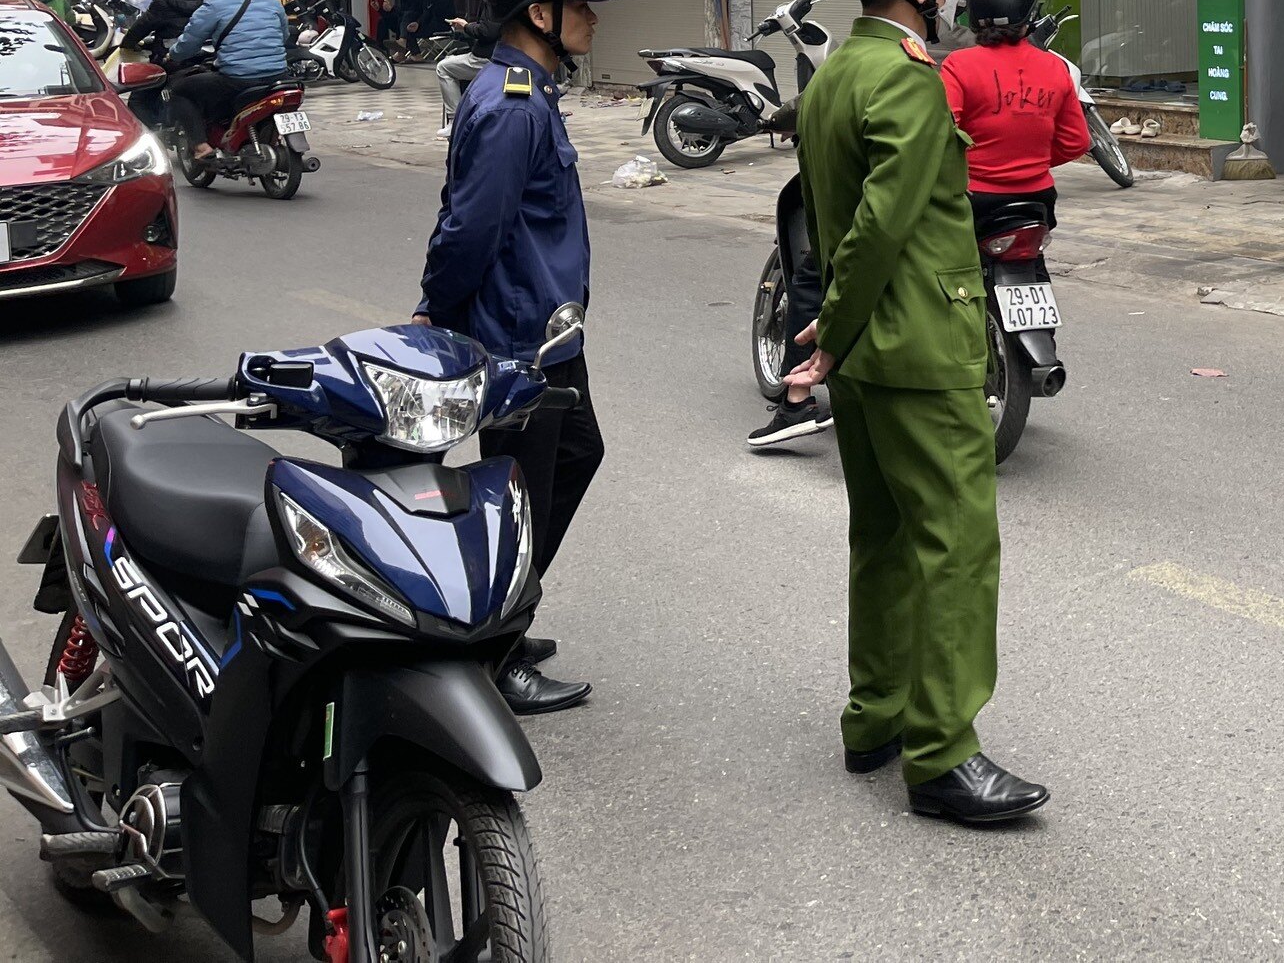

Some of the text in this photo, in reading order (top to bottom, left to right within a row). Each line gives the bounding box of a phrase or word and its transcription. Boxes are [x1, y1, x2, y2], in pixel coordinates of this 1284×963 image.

[992, 69, 1055, 115] Joker
[1006, 286, 1047, 306] 29-D1
[1008, 306, 1059, 328] 407.23
